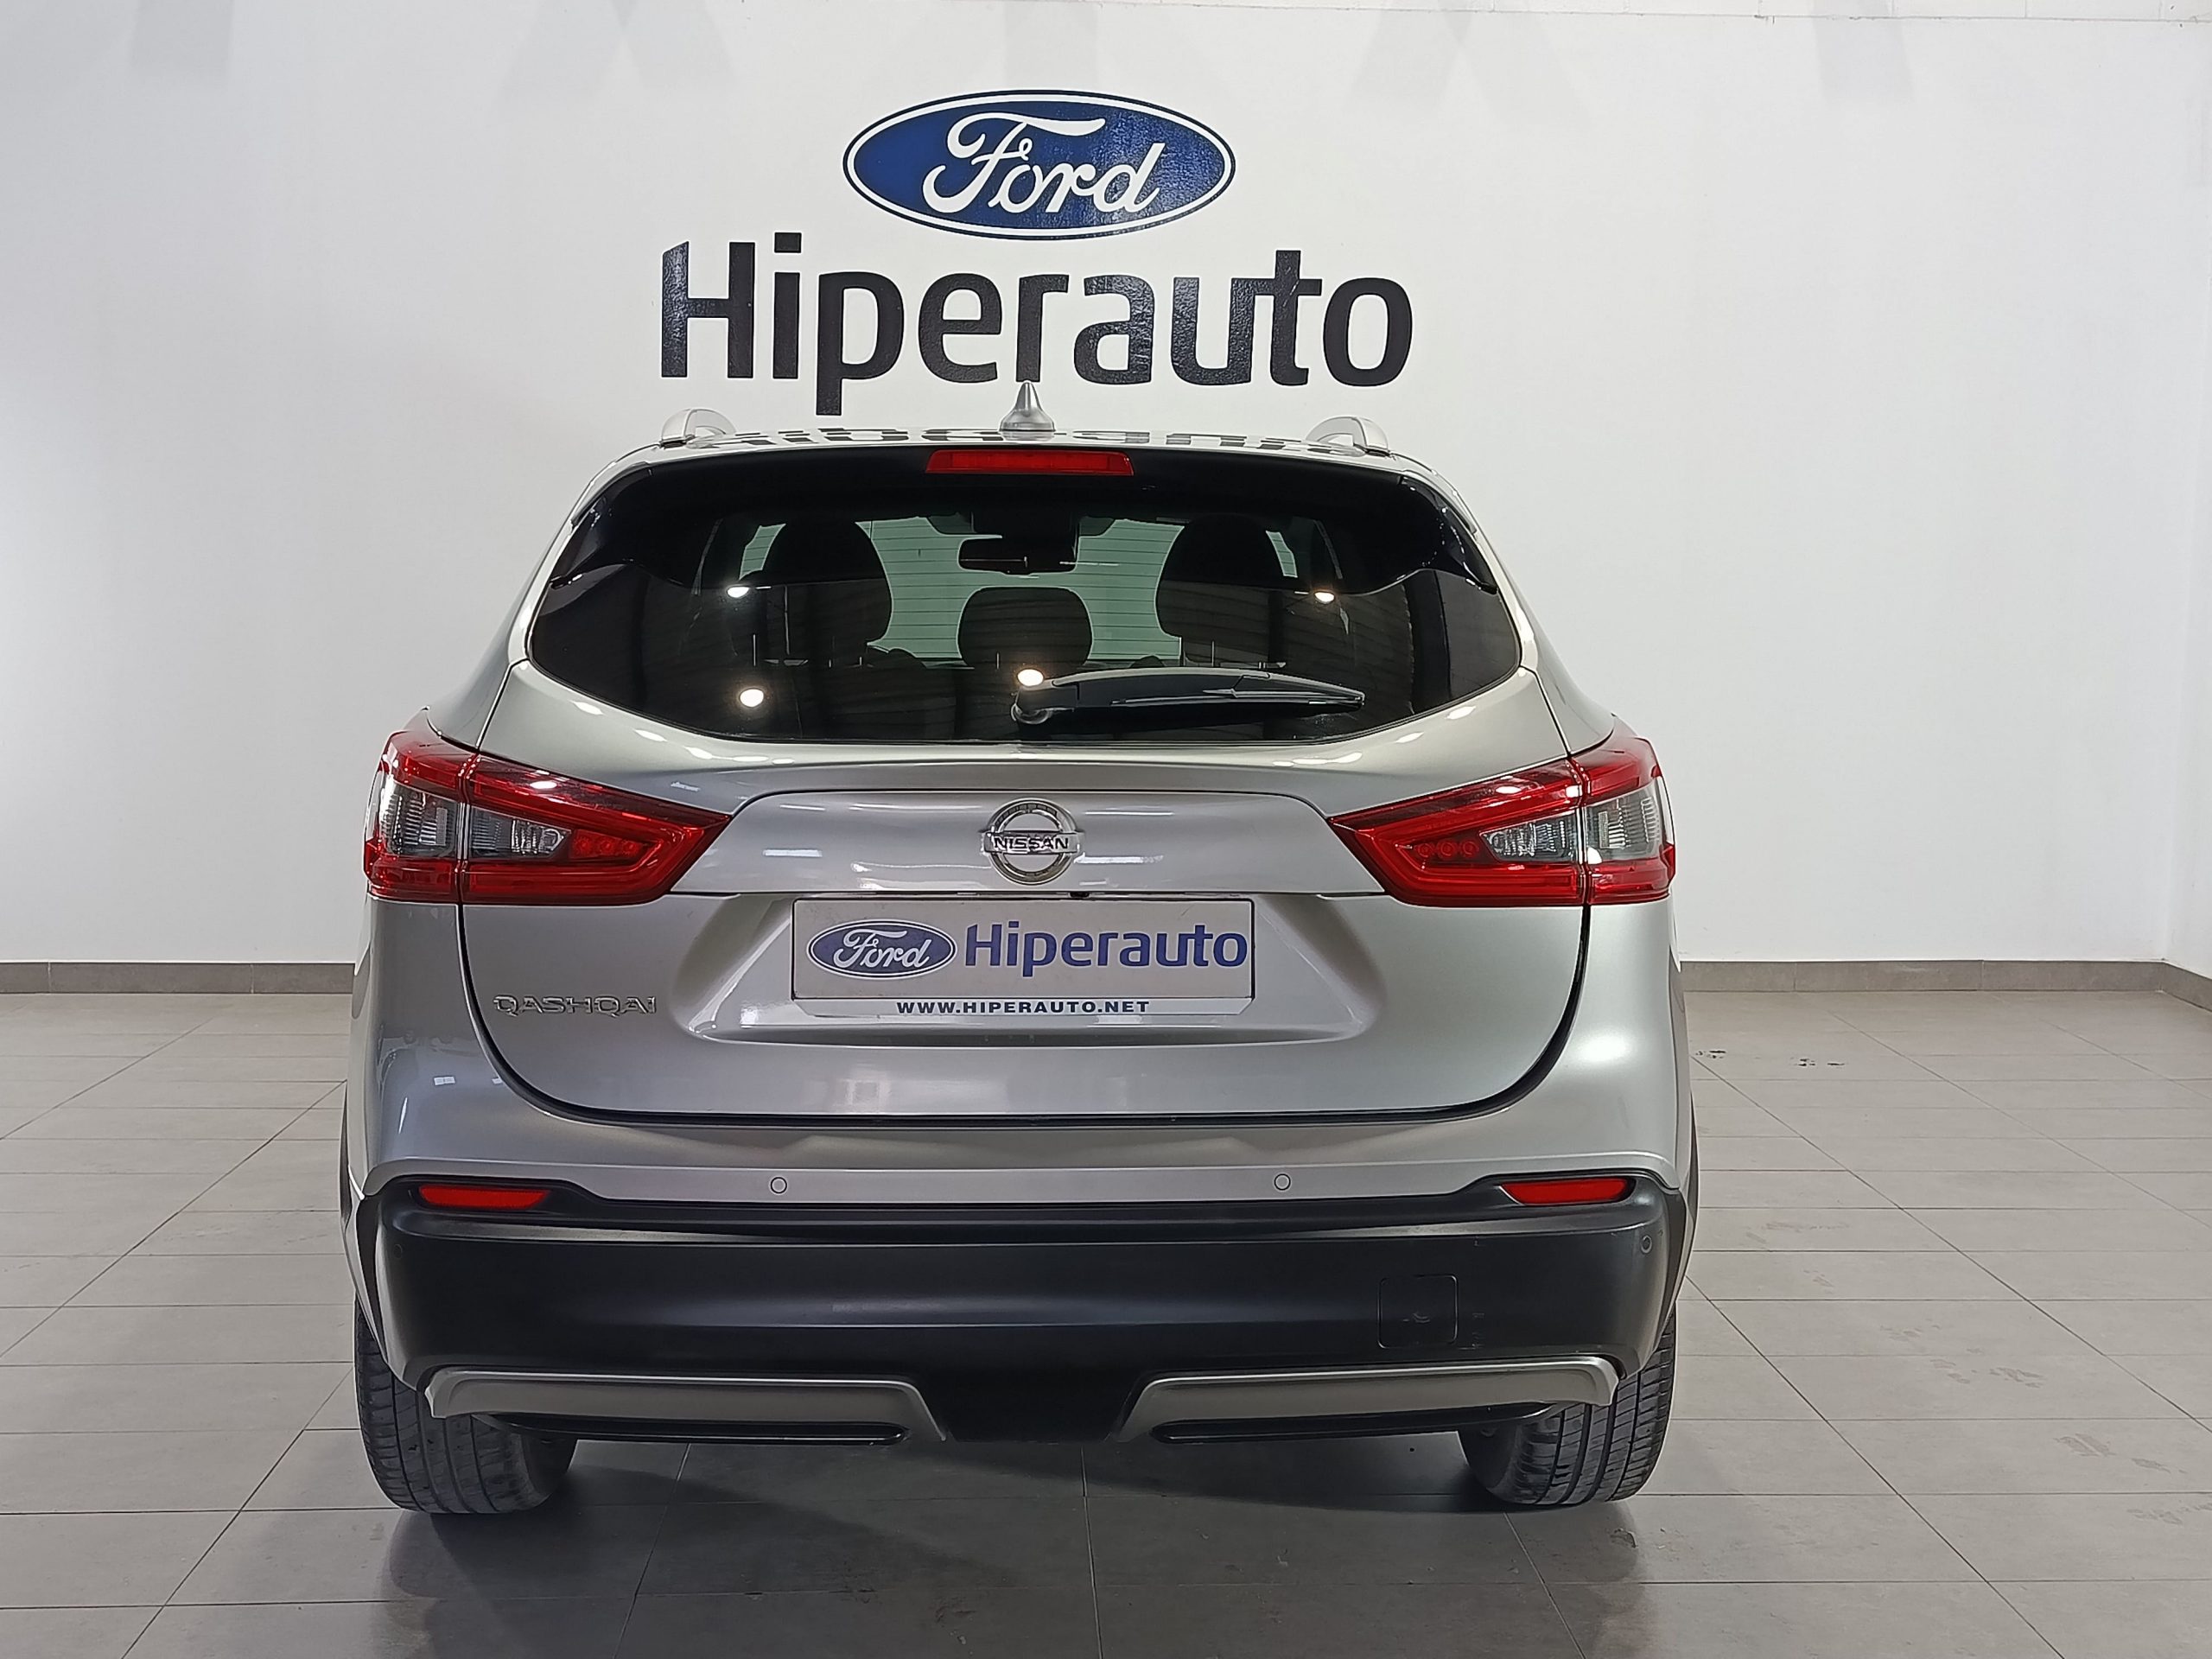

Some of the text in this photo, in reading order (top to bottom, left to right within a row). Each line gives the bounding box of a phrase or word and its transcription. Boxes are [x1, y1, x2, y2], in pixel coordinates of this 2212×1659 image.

[922, 111, 1166, 214] Ford
[660, 232, 1414, 416] Hiperauto
[994, 836, 1069, 849] NISSAN
[832, 927, 931, 969] Ford
[964, 920, 1249, 977] Hiperauto
[493, 995, 657, 1017] QASHQAI
[896, 1001, 1150, 1014] WWW.HIPERAUTO.NET
